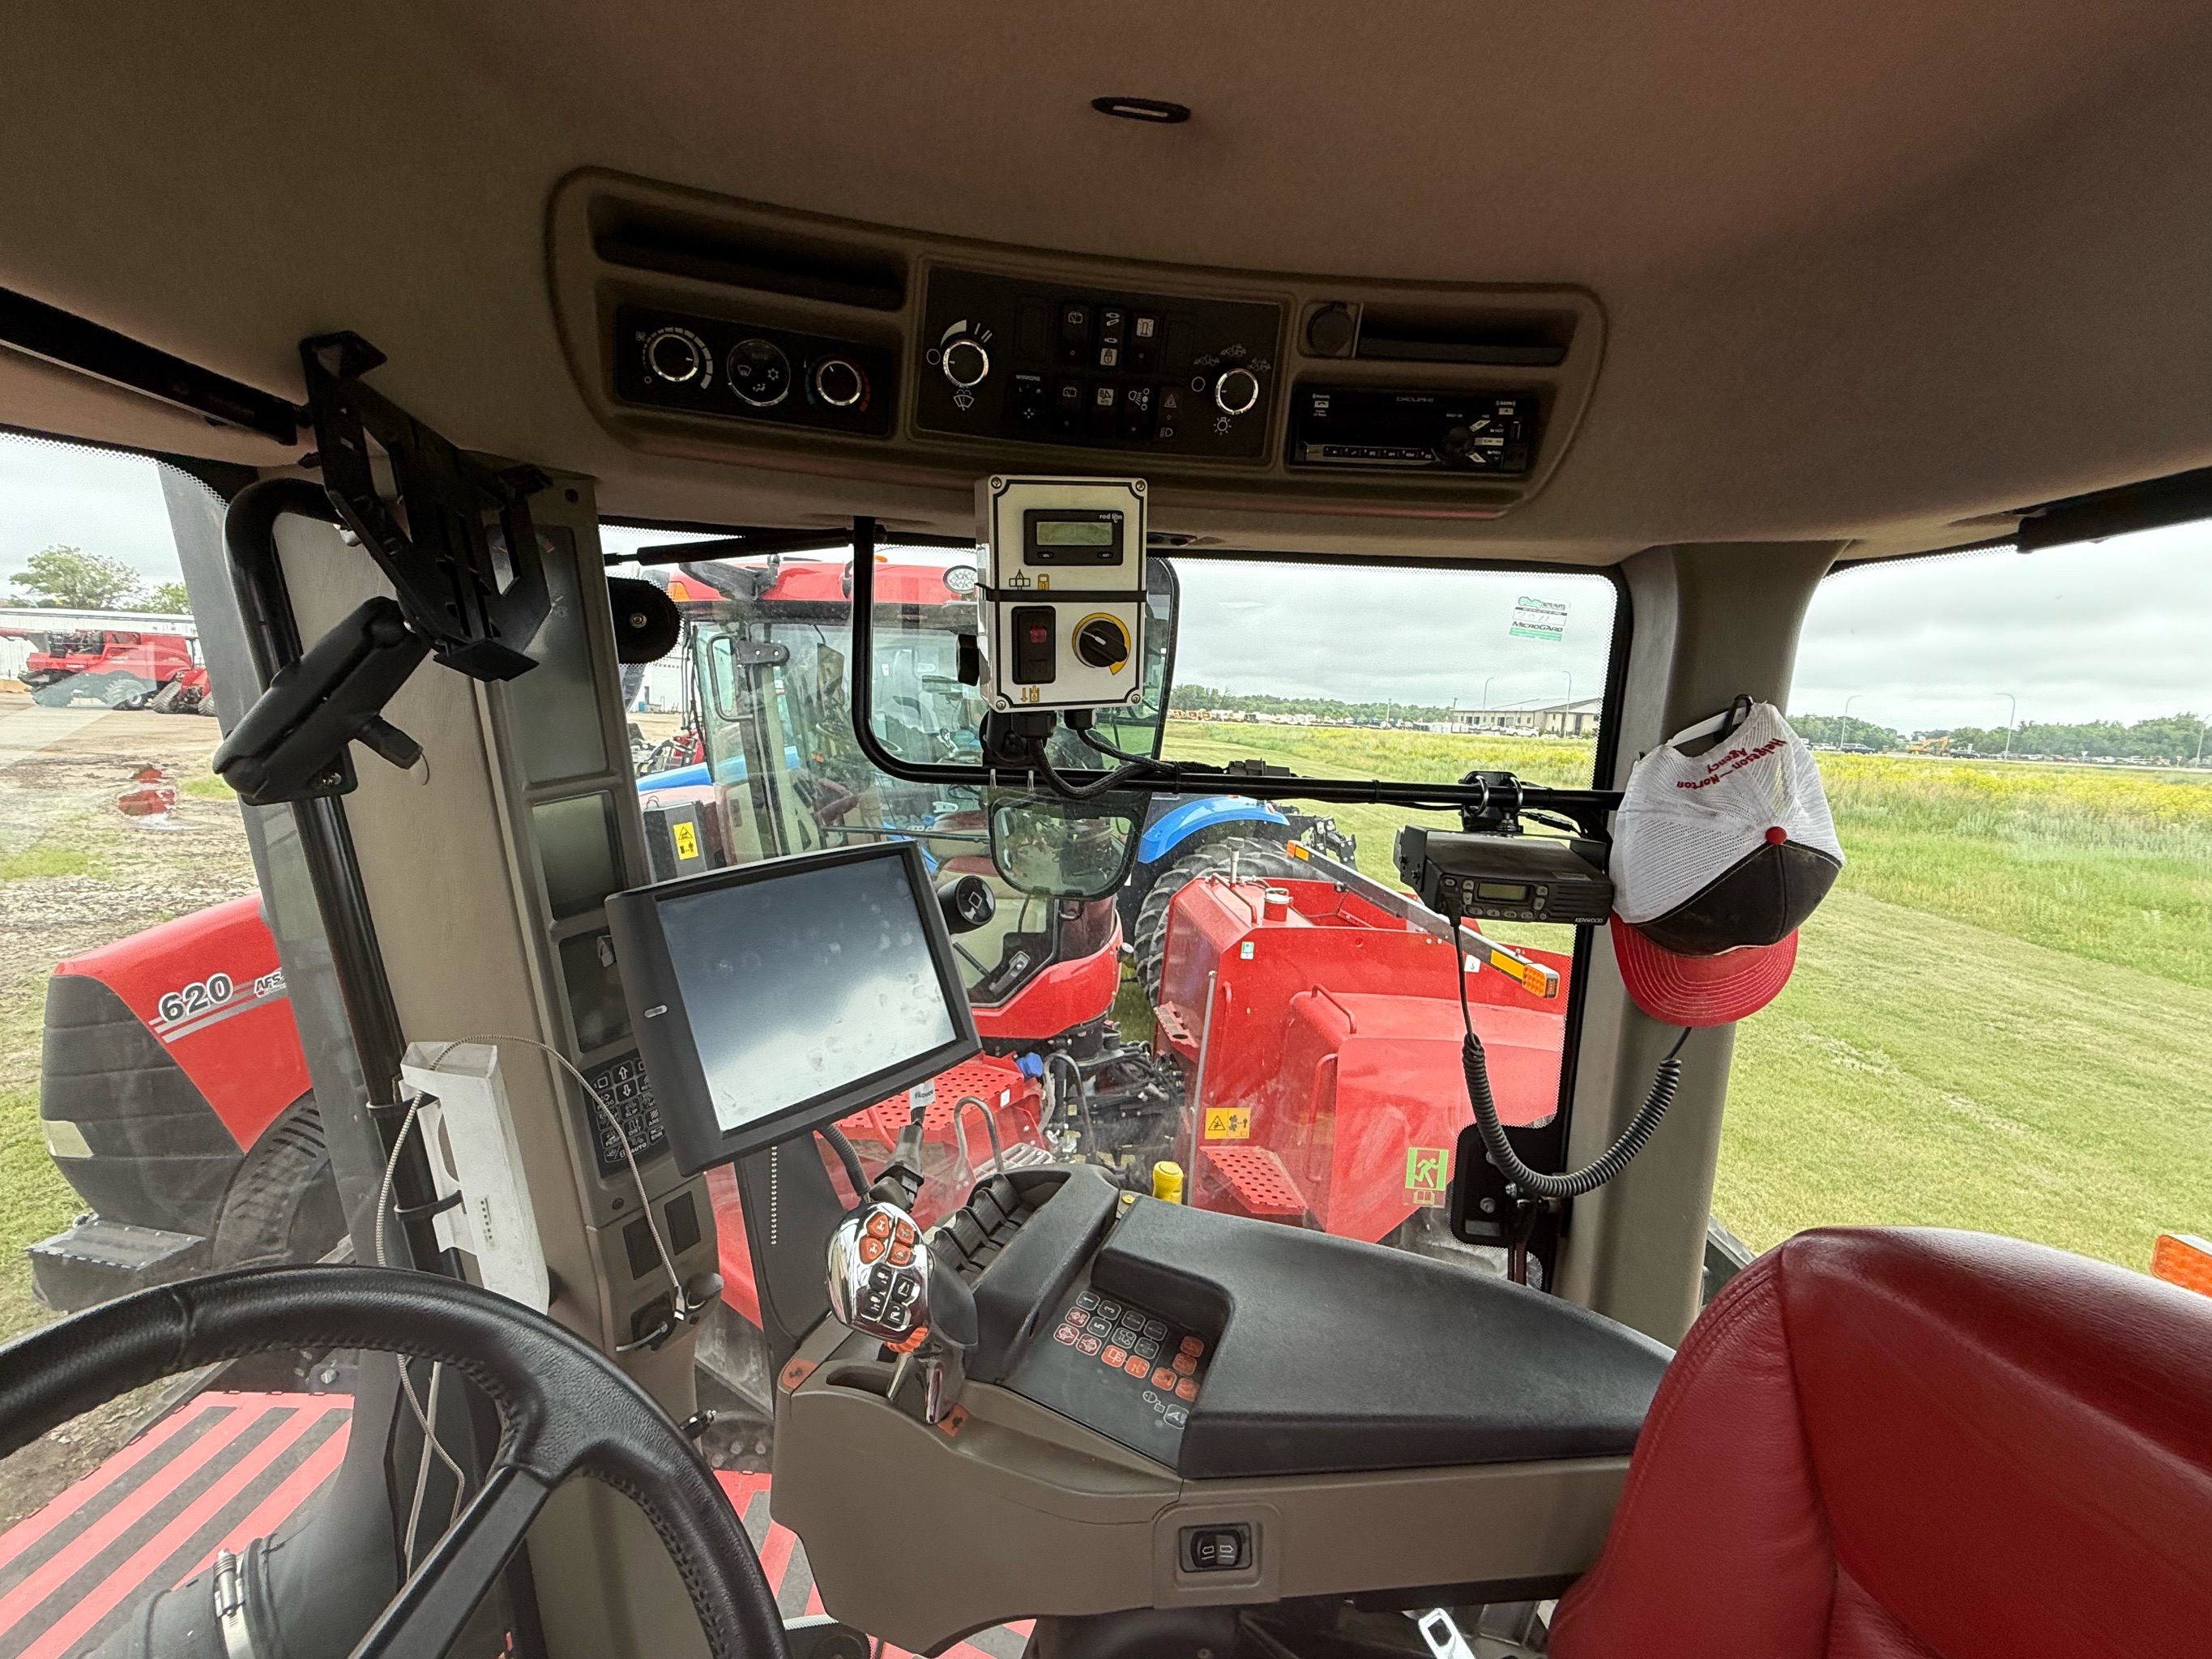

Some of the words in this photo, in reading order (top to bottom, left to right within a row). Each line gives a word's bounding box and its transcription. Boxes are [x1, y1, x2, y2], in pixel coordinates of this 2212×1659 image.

[1707, 748, 1748, 774] Agency
[1732, 738, 1787, 770] Helgeson
[1676, 774, 1720, 790] Norton
[158, 972, 234, 1023] 620
[254, 971, 282, 993] AFS
[628, 1126, 641, 1136] DIST
[631, 1142, 647, 1154] AUTO
[1104, 1306, 1116, 1314] 3
[1093, 1322, 1105, 1331] 5
